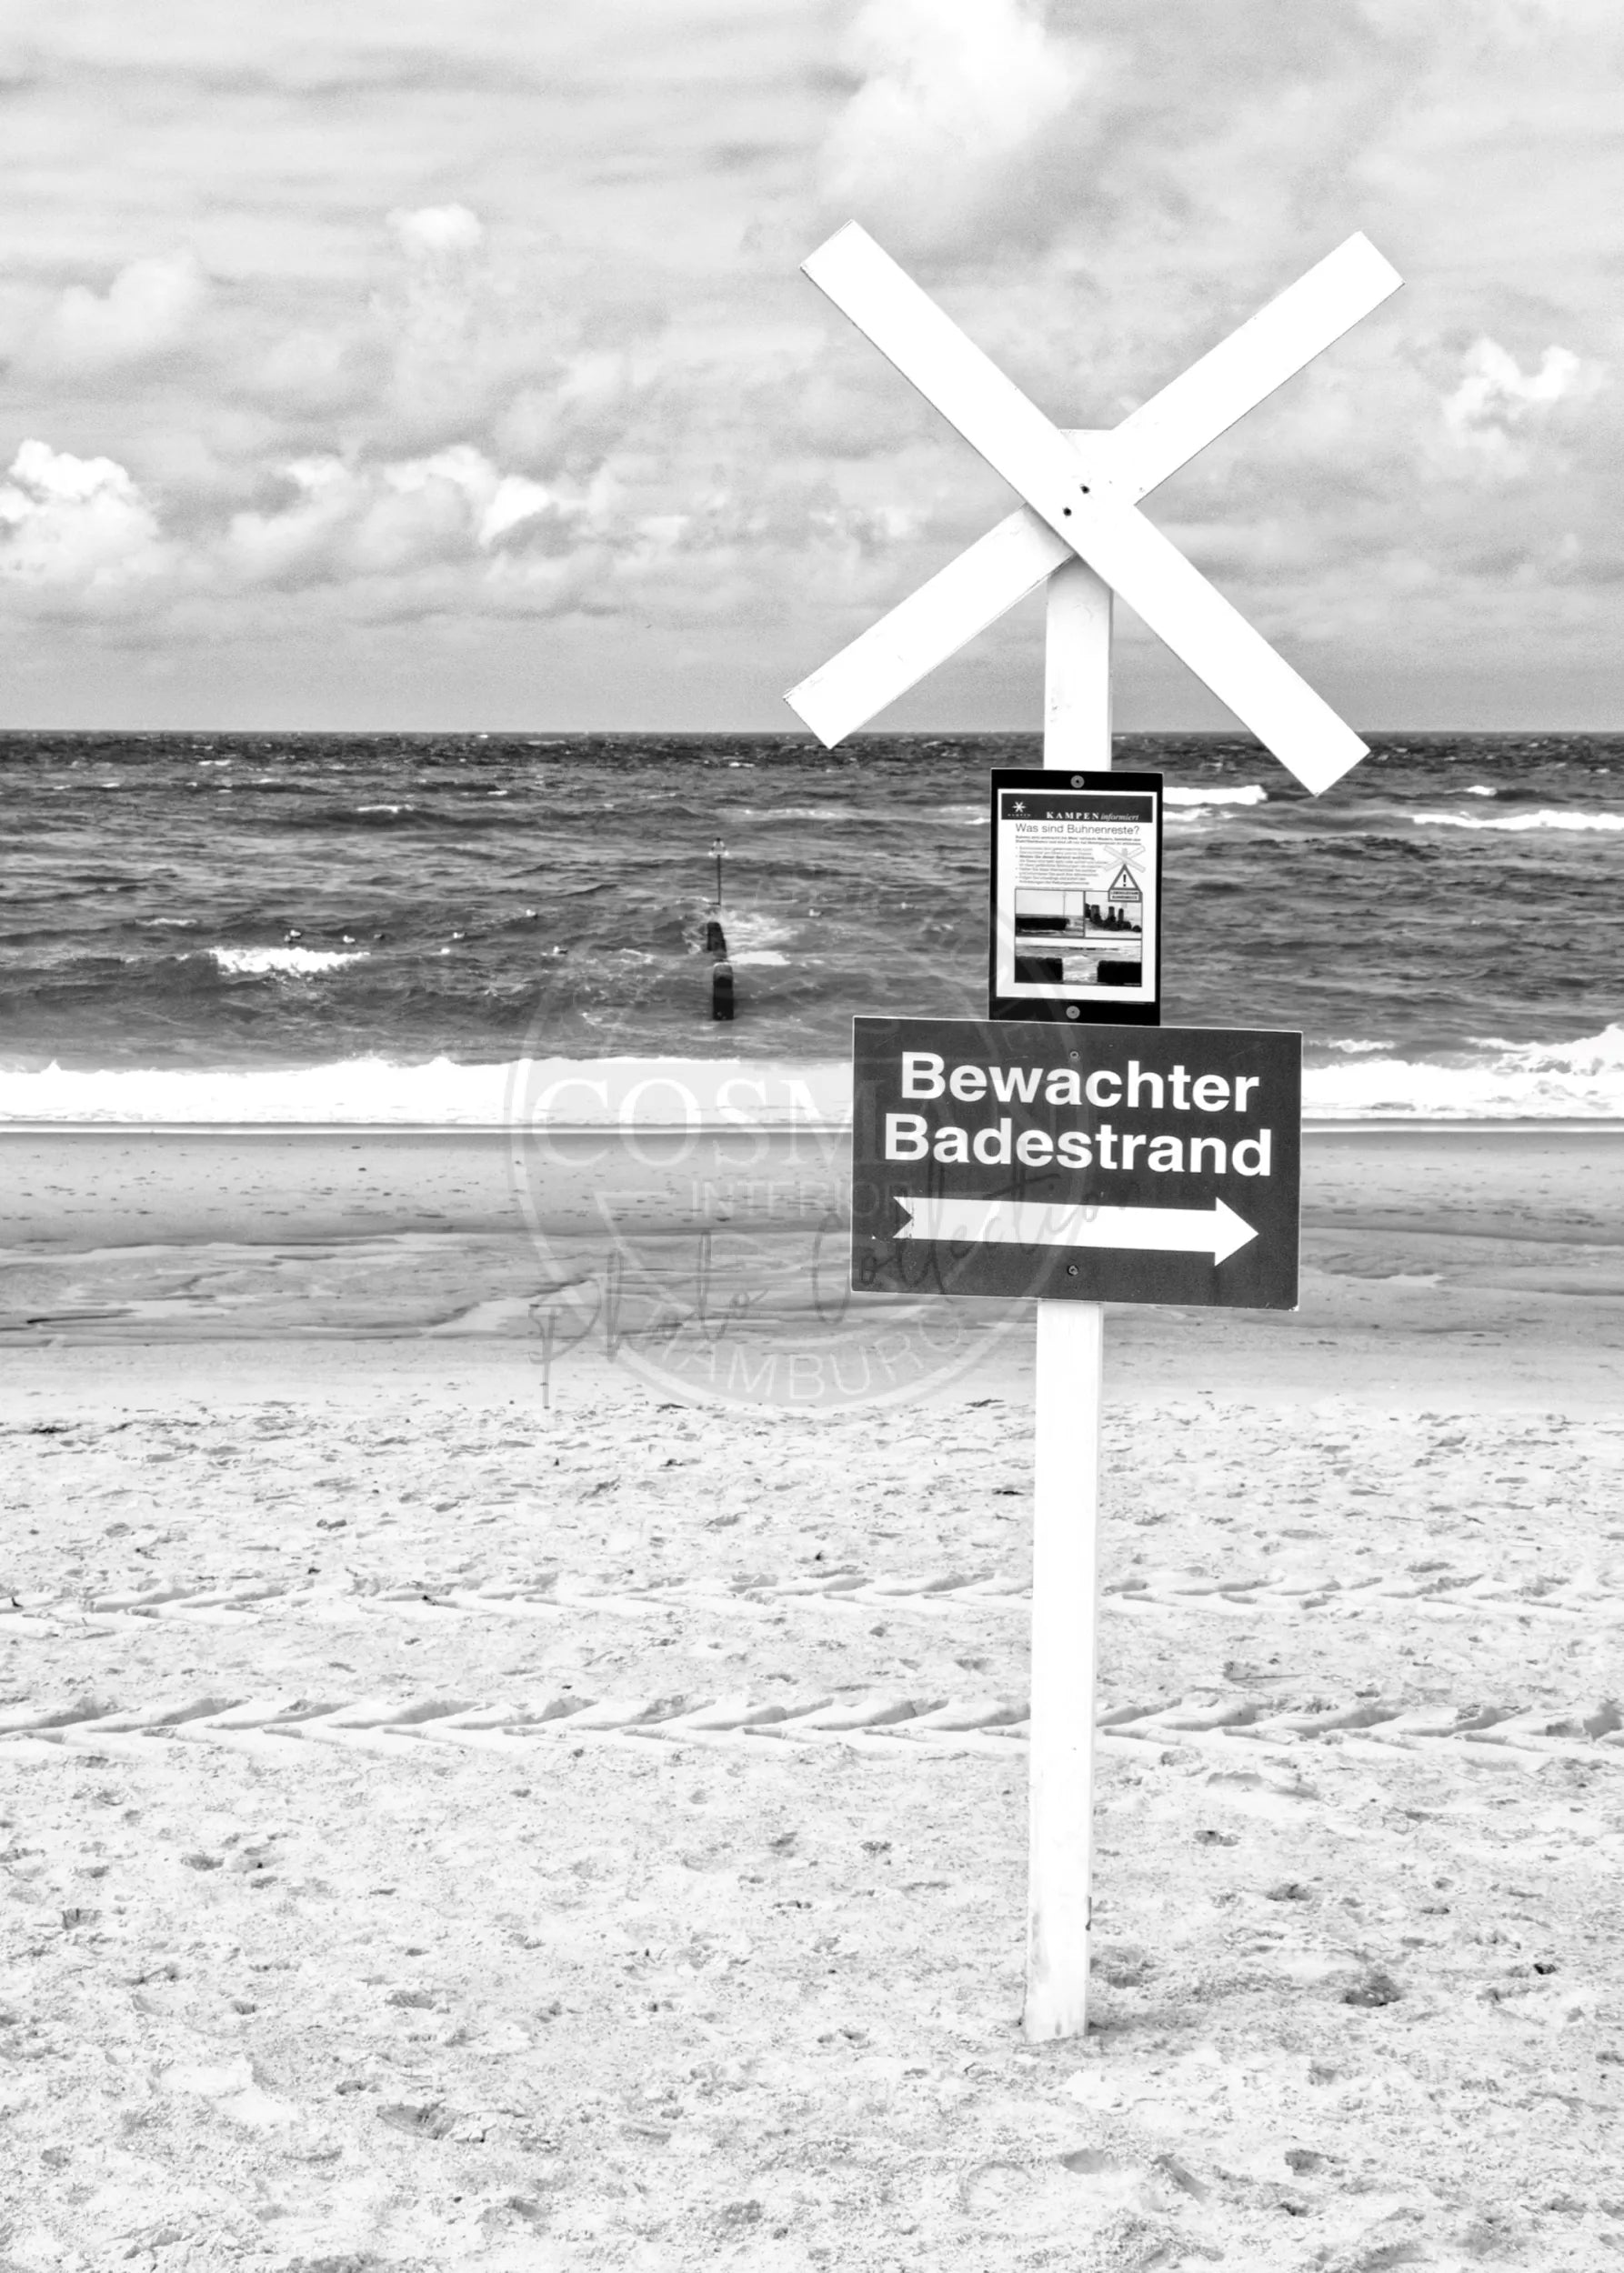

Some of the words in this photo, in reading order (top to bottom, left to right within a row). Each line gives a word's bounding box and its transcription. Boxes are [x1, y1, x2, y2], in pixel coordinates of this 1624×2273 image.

[1016, 824, 1038, 833] Was
[1042, 824, 1064, 833] sind
[1068, 825, 1139, 835] Buhnenreste?
[1047, 811, 1098, 820] KAMPEN
[1100, 812, 1139, 822] informiert
[901, 1051, 1260, 1113] Bewachter
[885, 1112, 1272, 1177] Badestrand
